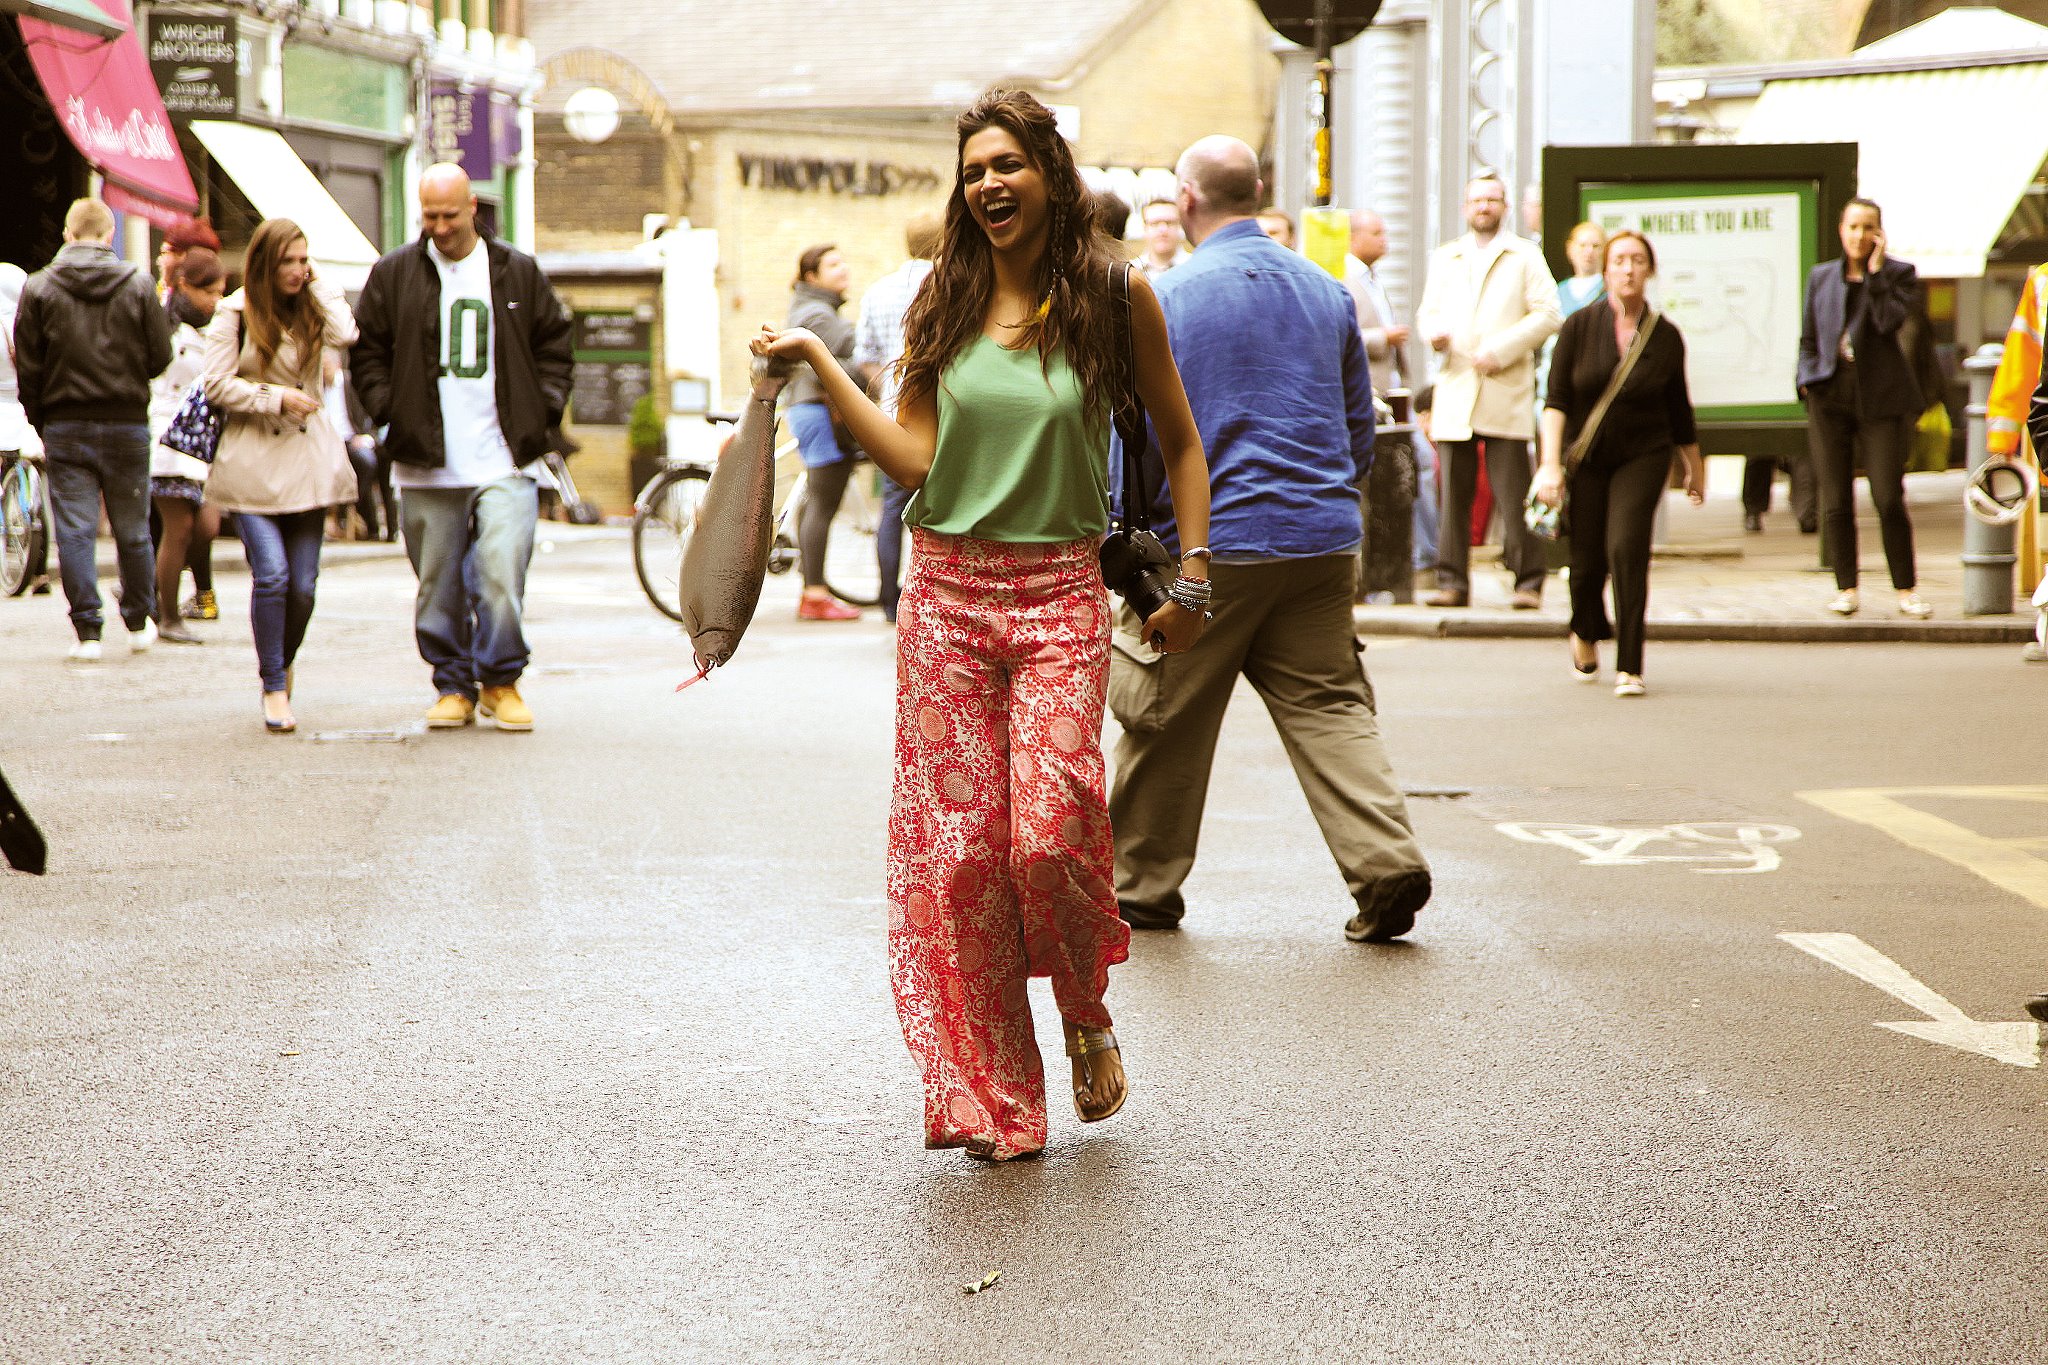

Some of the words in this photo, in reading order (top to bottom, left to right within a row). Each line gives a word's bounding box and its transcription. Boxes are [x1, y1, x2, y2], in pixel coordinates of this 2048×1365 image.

[158, 22, 226, 41] WRIGHT
[151, 40, 235, 63] BROTHERS
[1640, 211, 1696, 234] WHERE
[1704, 210, 1735, 233] YOU
[1742, 207, 1773, 230] ARE
